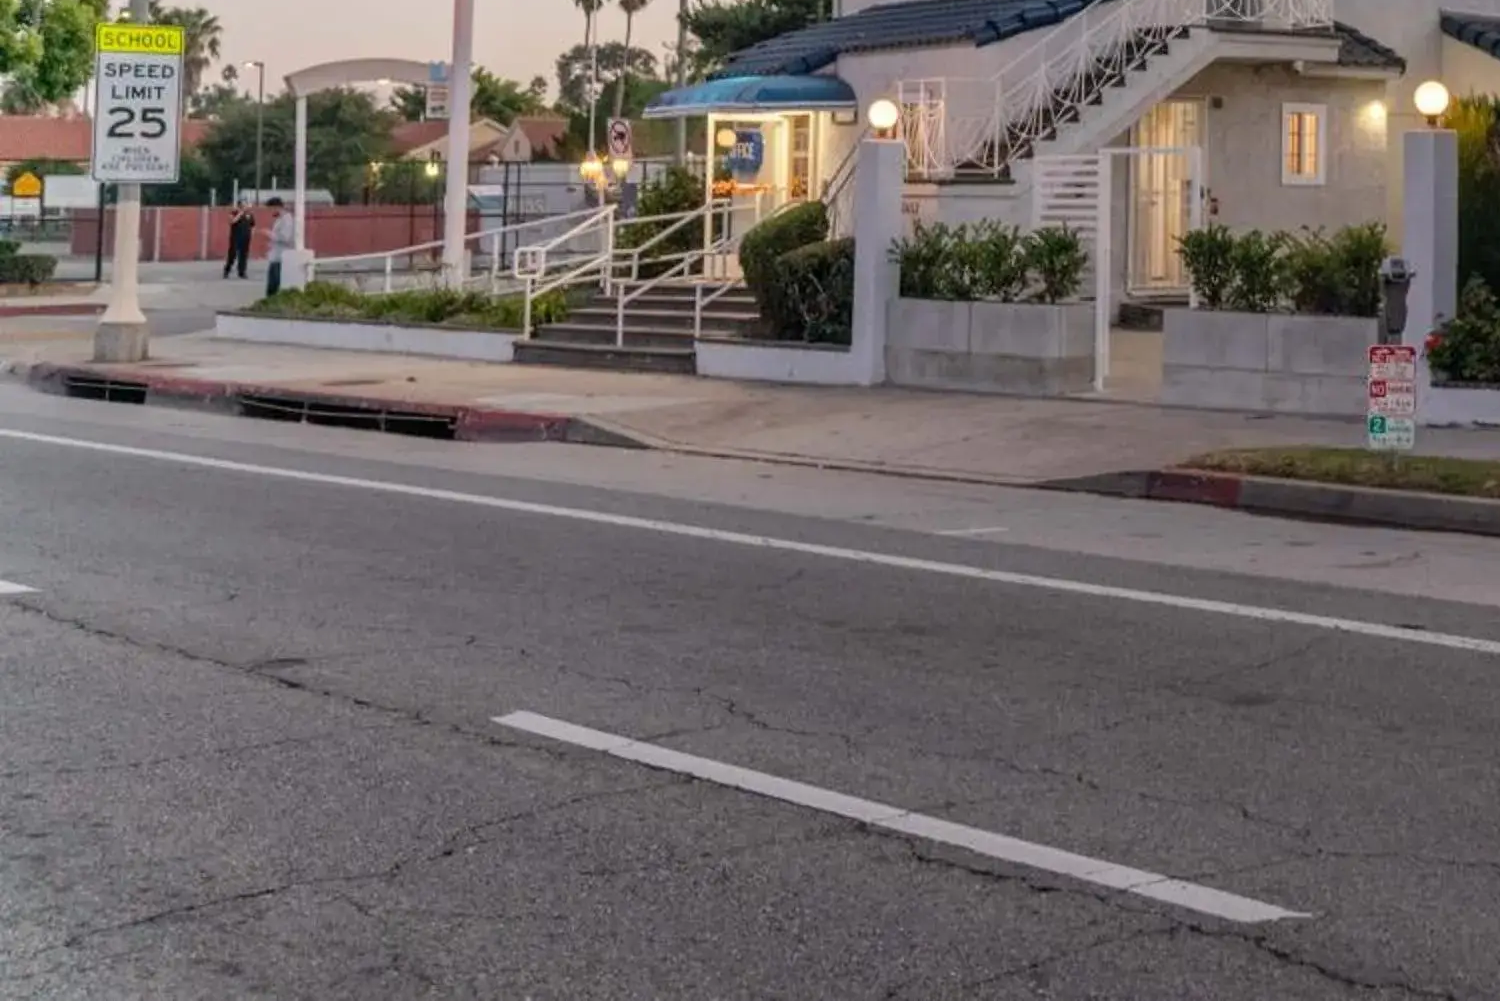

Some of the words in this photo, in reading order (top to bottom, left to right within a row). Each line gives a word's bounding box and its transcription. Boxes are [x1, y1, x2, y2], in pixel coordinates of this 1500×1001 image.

[103, 31, 177, 49] SCHOOL
[104, 62, 175, 79] SPEED
[111, 84, 166, 100] LIMIT
[107, 106, 167, 139] 25
